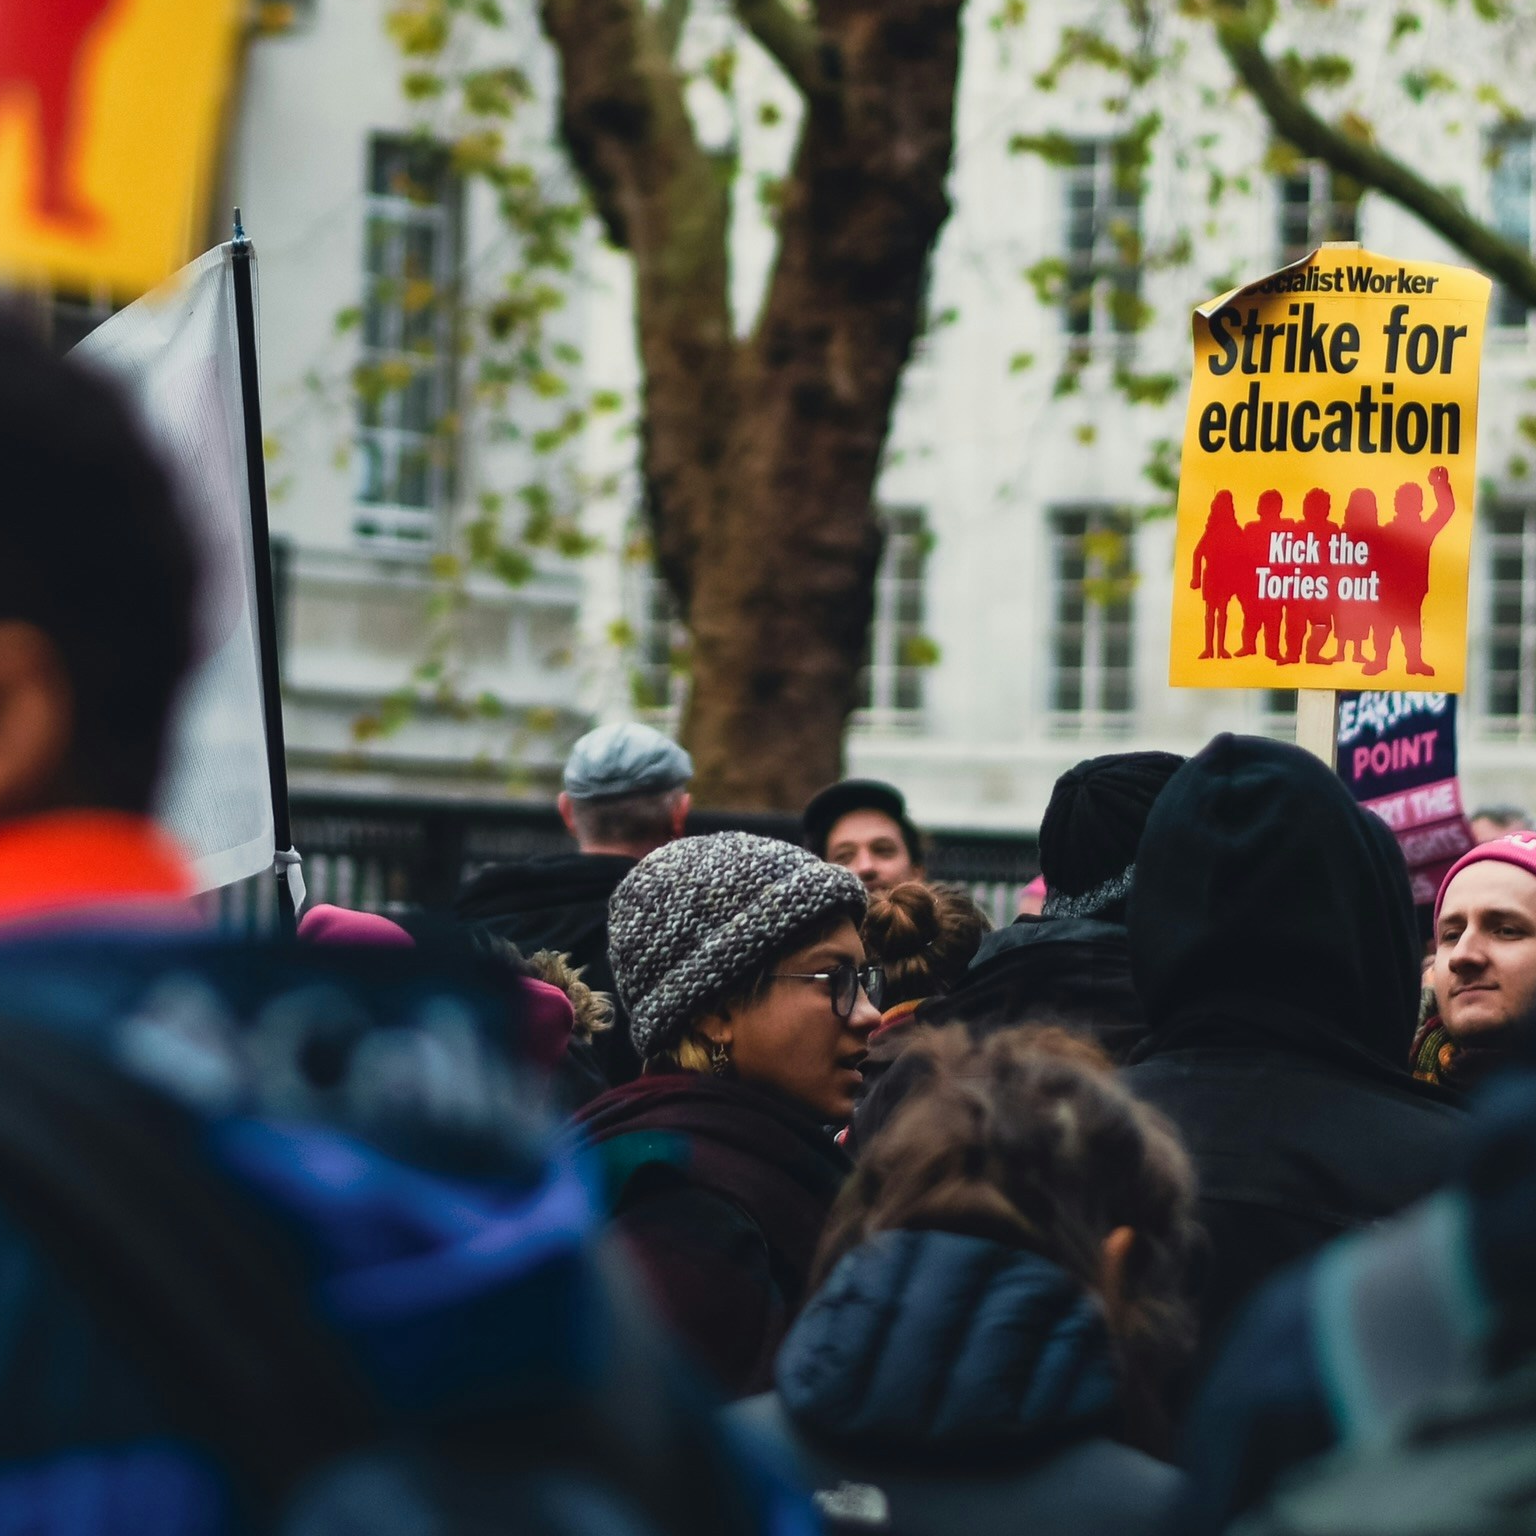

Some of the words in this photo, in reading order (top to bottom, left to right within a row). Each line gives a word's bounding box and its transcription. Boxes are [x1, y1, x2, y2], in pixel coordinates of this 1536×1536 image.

[1243, 265, 1344, 296] ocialist
[1346, 265, 1439, 294] Worker
[1207, 302, 1361, 376] Strike
[1383, 304, 1468, 375] for
[1198, 381, 1461, 455] education
[1268, 531, 1320, 564] Kick
[1328, 532, 1369, 565] the
[1255, 567, 1329, 600] Tories
[1337, 570, 1380, 602] out
[1352, 729, 1439, 781] POINT
